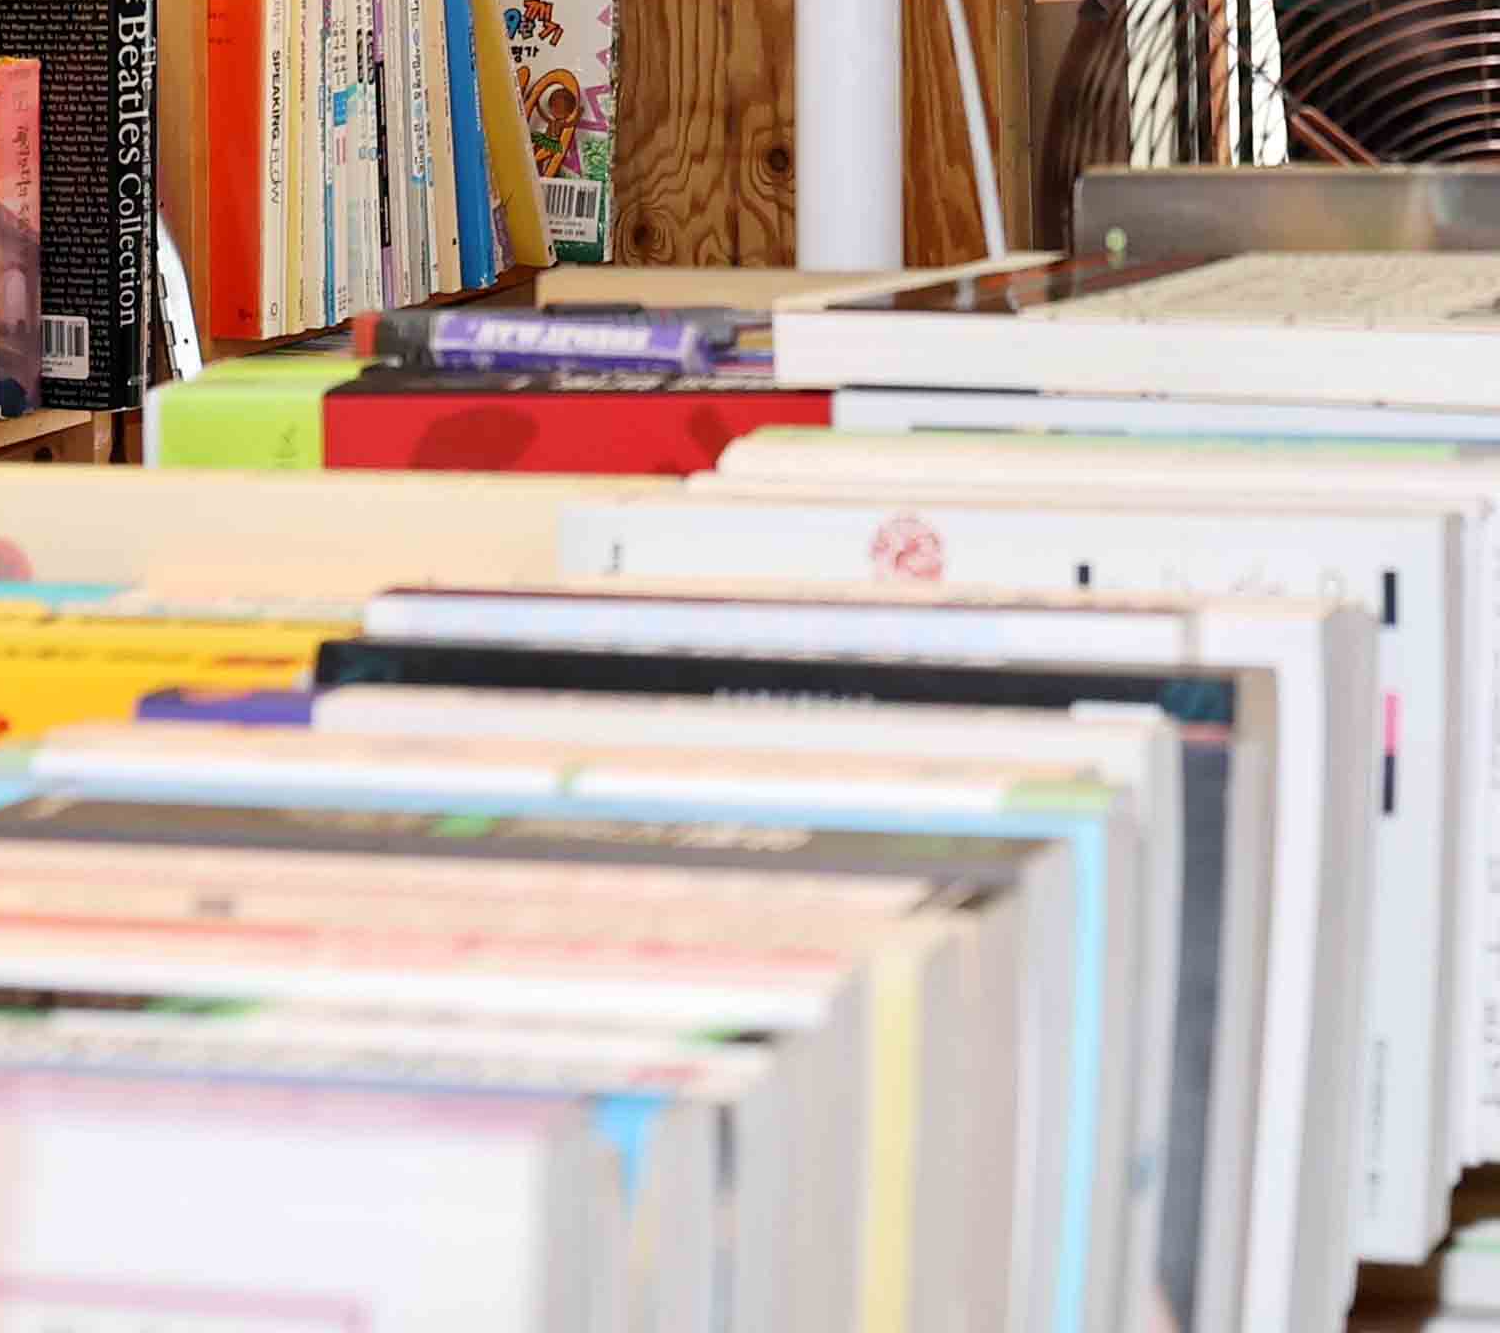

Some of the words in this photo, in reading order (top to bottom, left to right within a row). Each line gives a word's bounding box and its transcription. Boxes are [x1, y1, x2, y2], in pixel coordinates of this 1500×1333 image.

[117, 13, 149, 166] Beatles
[140, 35, 158, 93] The
[270, 49, 282, 142] SPEAKING
[116, 172, 143, 328] Collection
